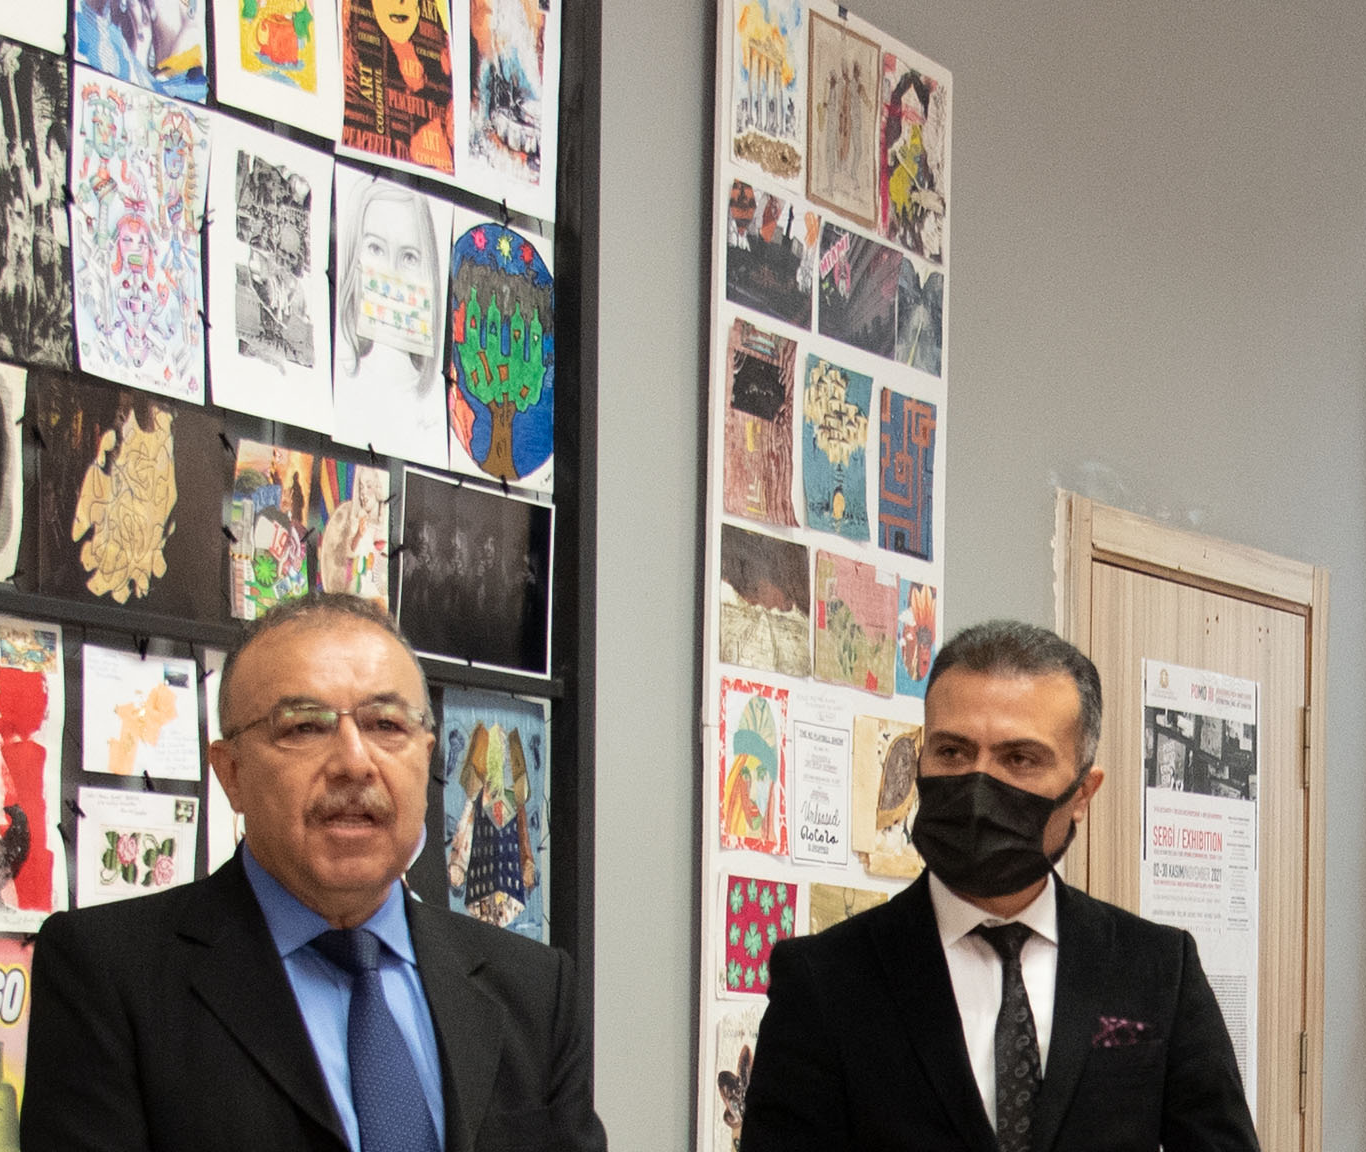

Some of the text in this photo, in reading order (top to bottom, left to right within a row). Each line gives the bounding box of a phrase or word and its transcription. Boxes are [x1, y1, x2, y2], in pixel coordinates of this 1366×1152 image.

[359, 61, 374, 102] ART
[375, 67, 385, 135] COLORFUL
[1182, 828, 1223, 853] EXHIBITION
